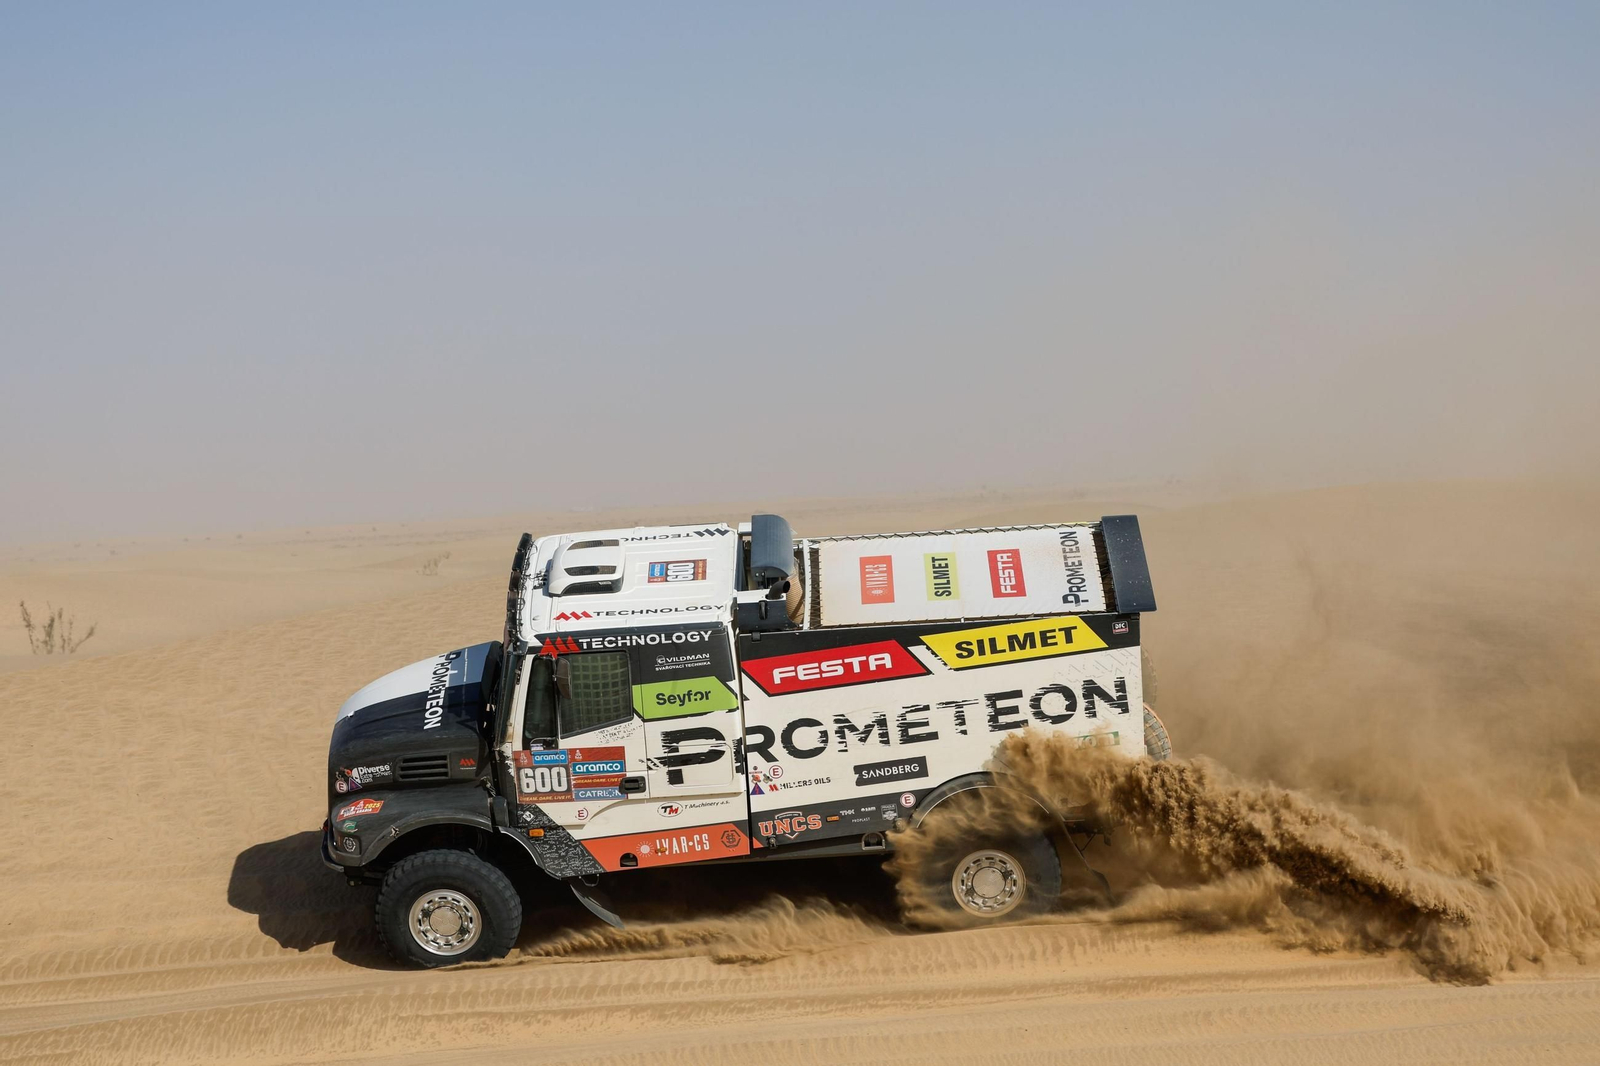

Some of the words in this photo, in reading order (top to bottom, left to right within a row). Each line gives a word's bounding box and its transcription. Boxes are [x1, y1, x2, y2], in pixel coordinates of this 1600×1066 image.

[667, 562, 694, 581] 600
[932, 556, 952, 597] SILMET
[996, 552, 1017, 594] FESTA
[1059, 530, 1089, 607] PROMETEON
[593, 604, 724, 617] TECHNOLOGY
[578, 630, 713, 650] TECHNOLOGY
[955, 625, 1077, 659] SILMET
[666, 653, 710, 662] VILDMAN
[773, 653, 893, 685] FESTA
[423, 651, 461, 730] PROMETEON
[655, 689, 711, 707] Seyfor
[649, 677, 1131, 785] PROMETEON
[358, 764, 390, 775] Diverse
[575, 762, 621, 772] aramco
[862, 763, 920, 779] SANDBERG
[519, 766, 568, 794] 600
[814, 777, 831, 785] OILS
[758, 814, 822, 836] UNCS
